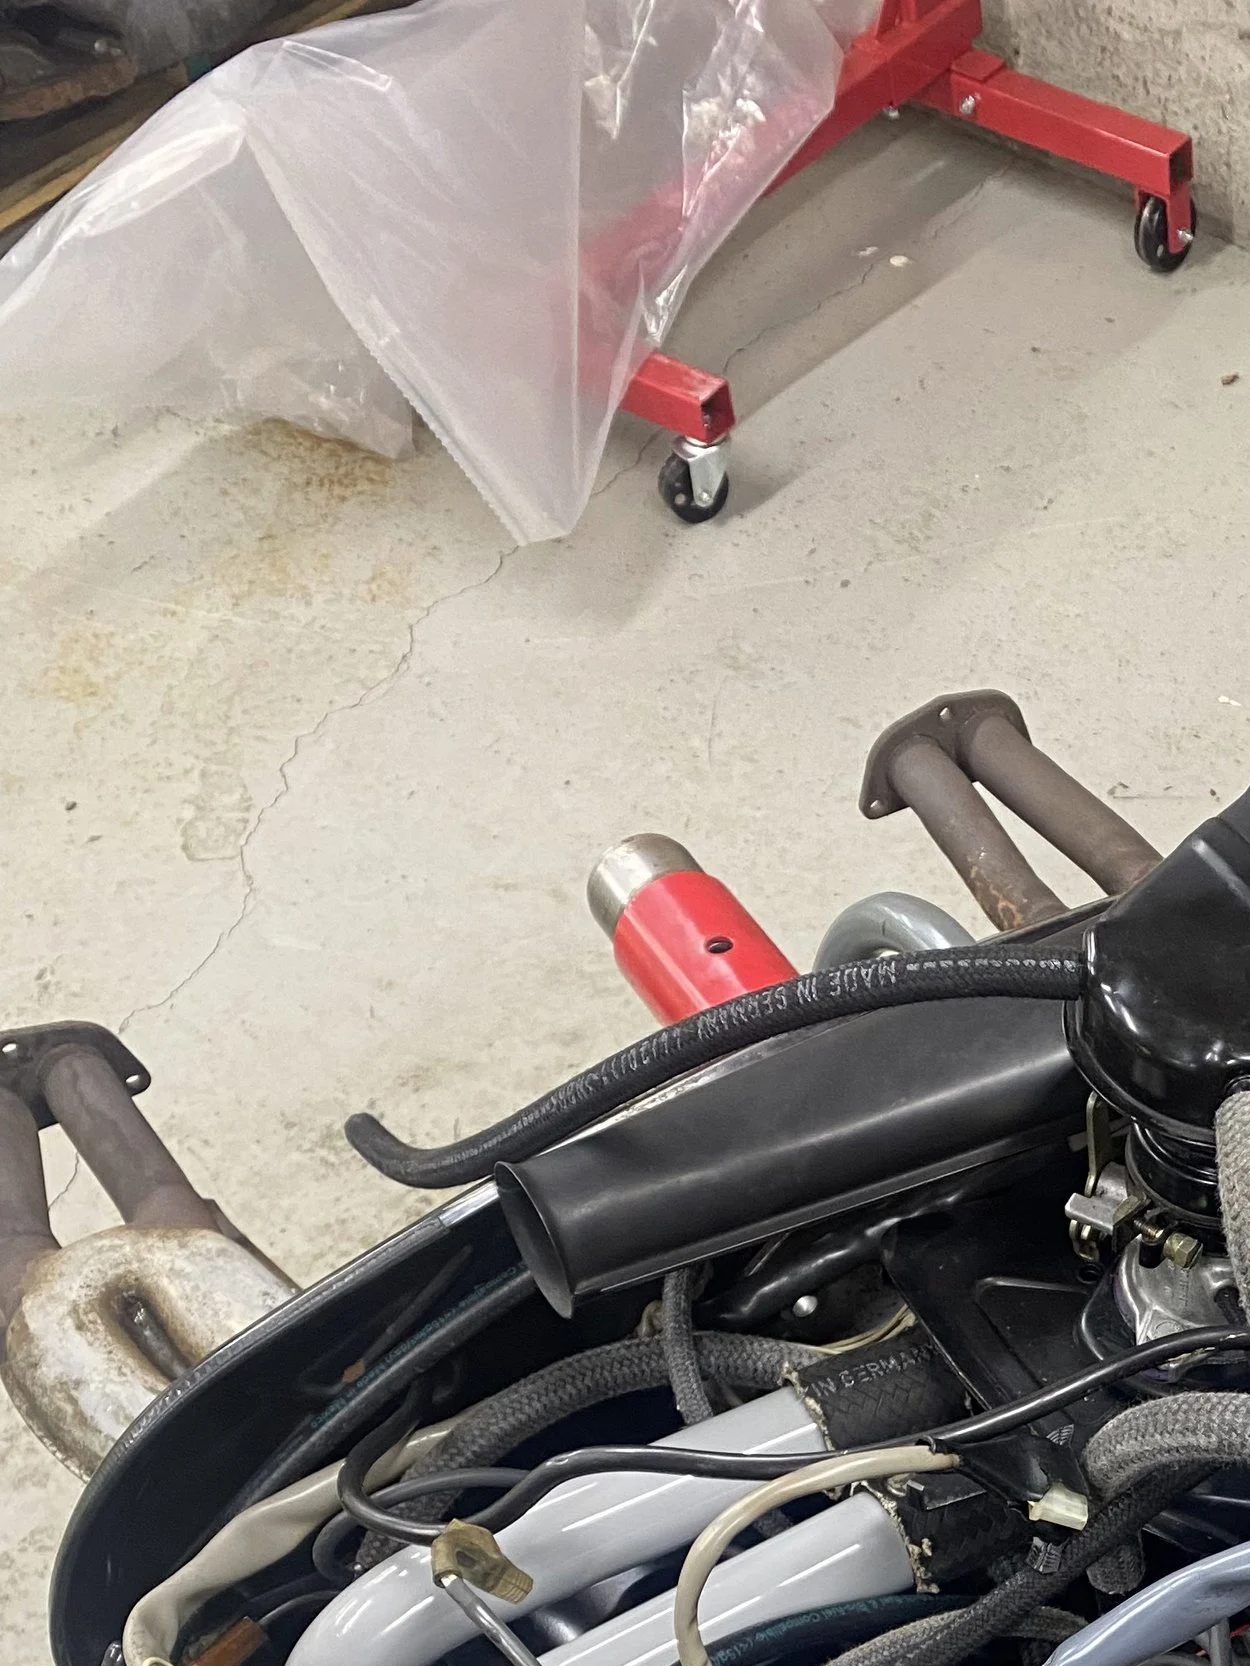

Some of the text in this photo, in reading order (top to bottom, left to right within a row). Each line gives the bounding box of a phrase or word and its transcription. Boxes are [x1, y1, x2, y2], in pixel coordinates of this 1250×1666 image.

[796, 978, 819, 1004] IN
[829, 959, 897, 997] MADE
[811, 1378, 838, 1399] IN
